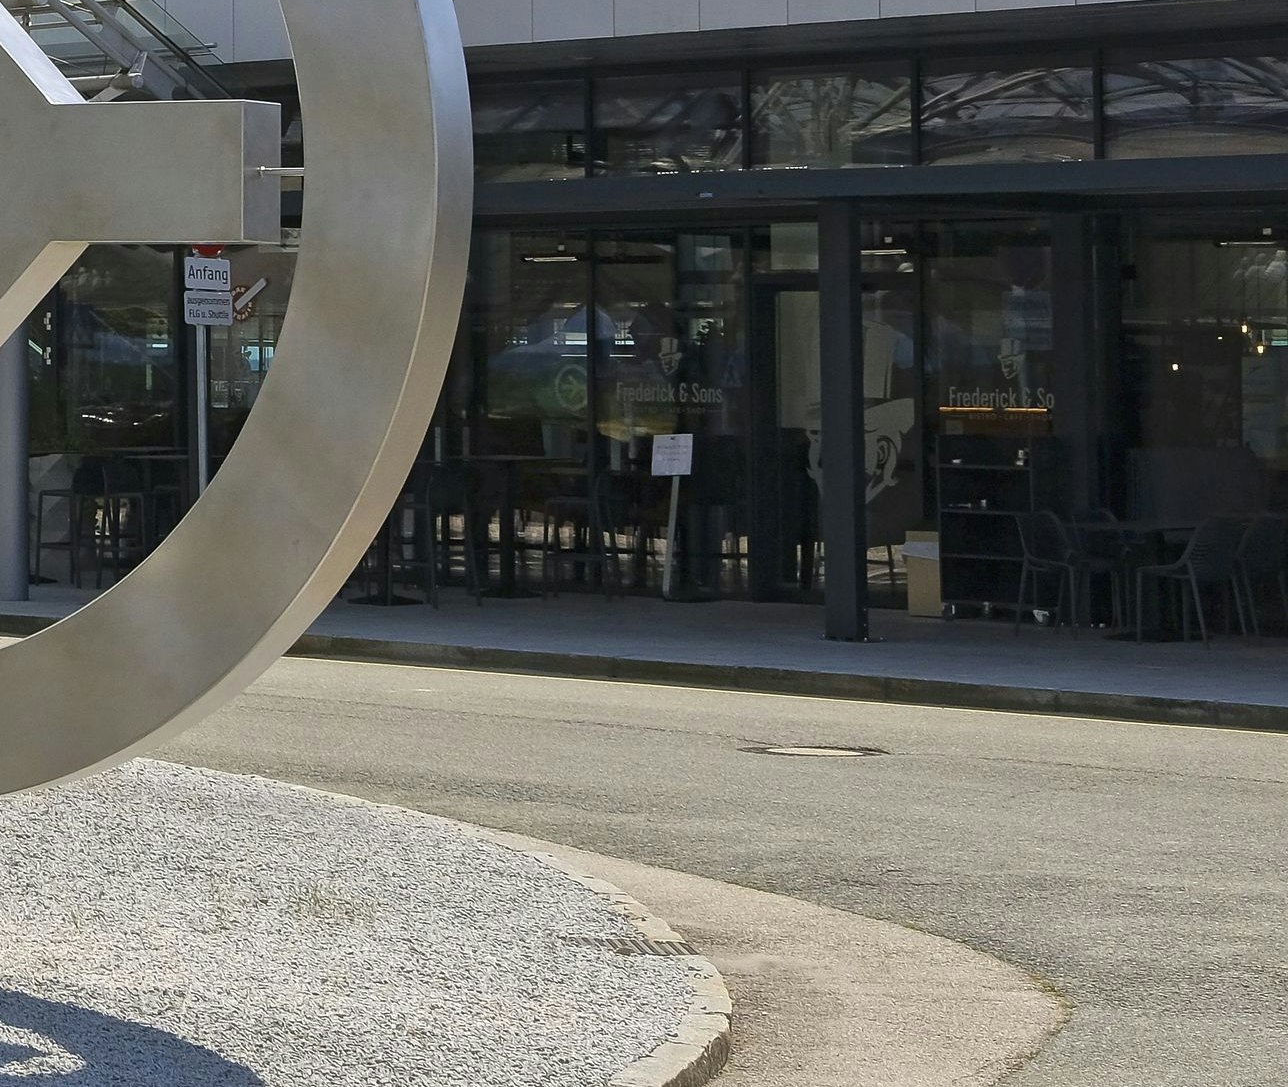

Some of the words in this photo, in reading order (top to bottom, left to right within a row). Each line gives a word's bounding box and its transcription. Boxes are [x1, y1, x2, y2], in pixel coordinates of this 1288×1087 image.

[188, 265, 228, 284] Anfang
[189, 309, 201, 318] FLG
[616, 381, 676, 402] Frederick
[679, 382, 689, 403] &
[691, 382, 723, 403] Sons
[948, 386, 1017, 408] Frederick
[1037, 387, 1055, 409] So
